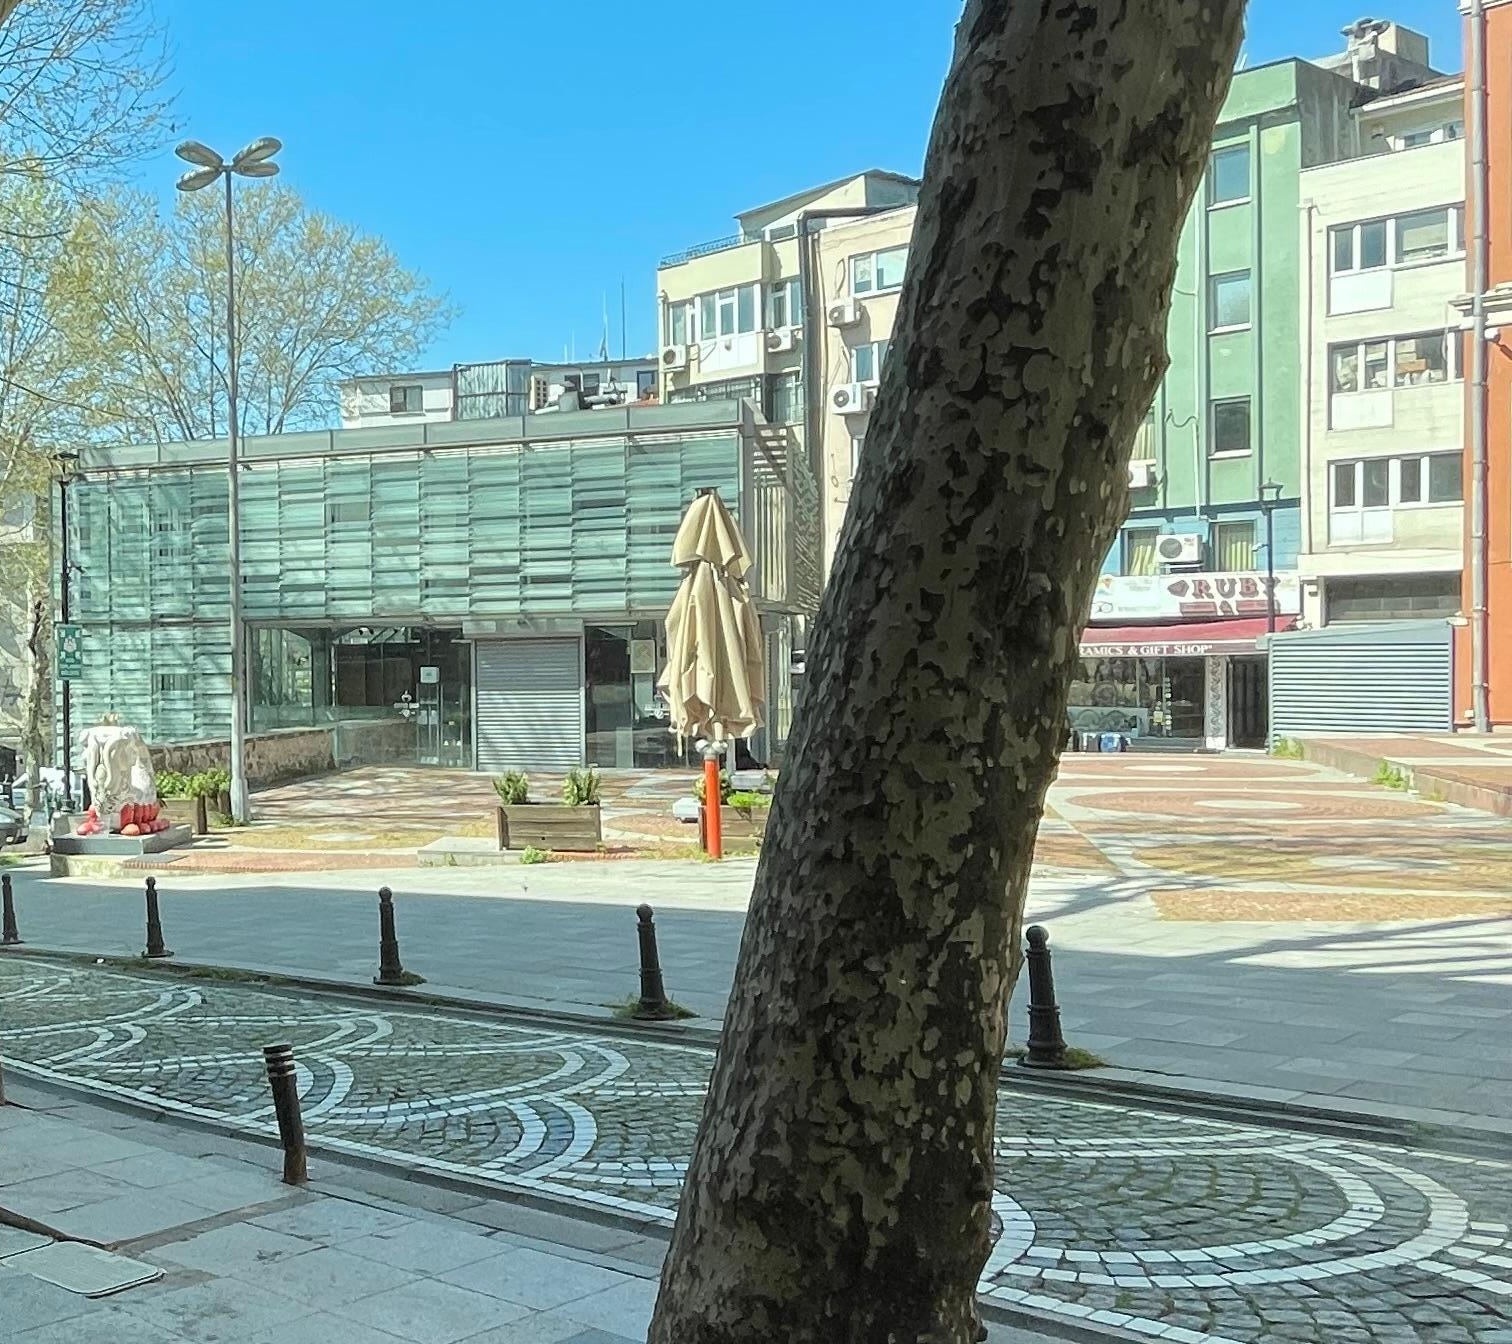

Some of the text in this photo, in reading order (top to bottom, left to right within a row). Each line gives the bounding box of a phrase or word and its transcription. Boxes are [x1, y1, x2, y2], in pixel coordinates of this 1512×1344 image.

[1192, 576, 1281, 599] RUBY
[1079, 645, 1124, 656] RAMICS
[1127, 645, 1138, 656] &
[1139, 645, 1170, 655] GIFT
